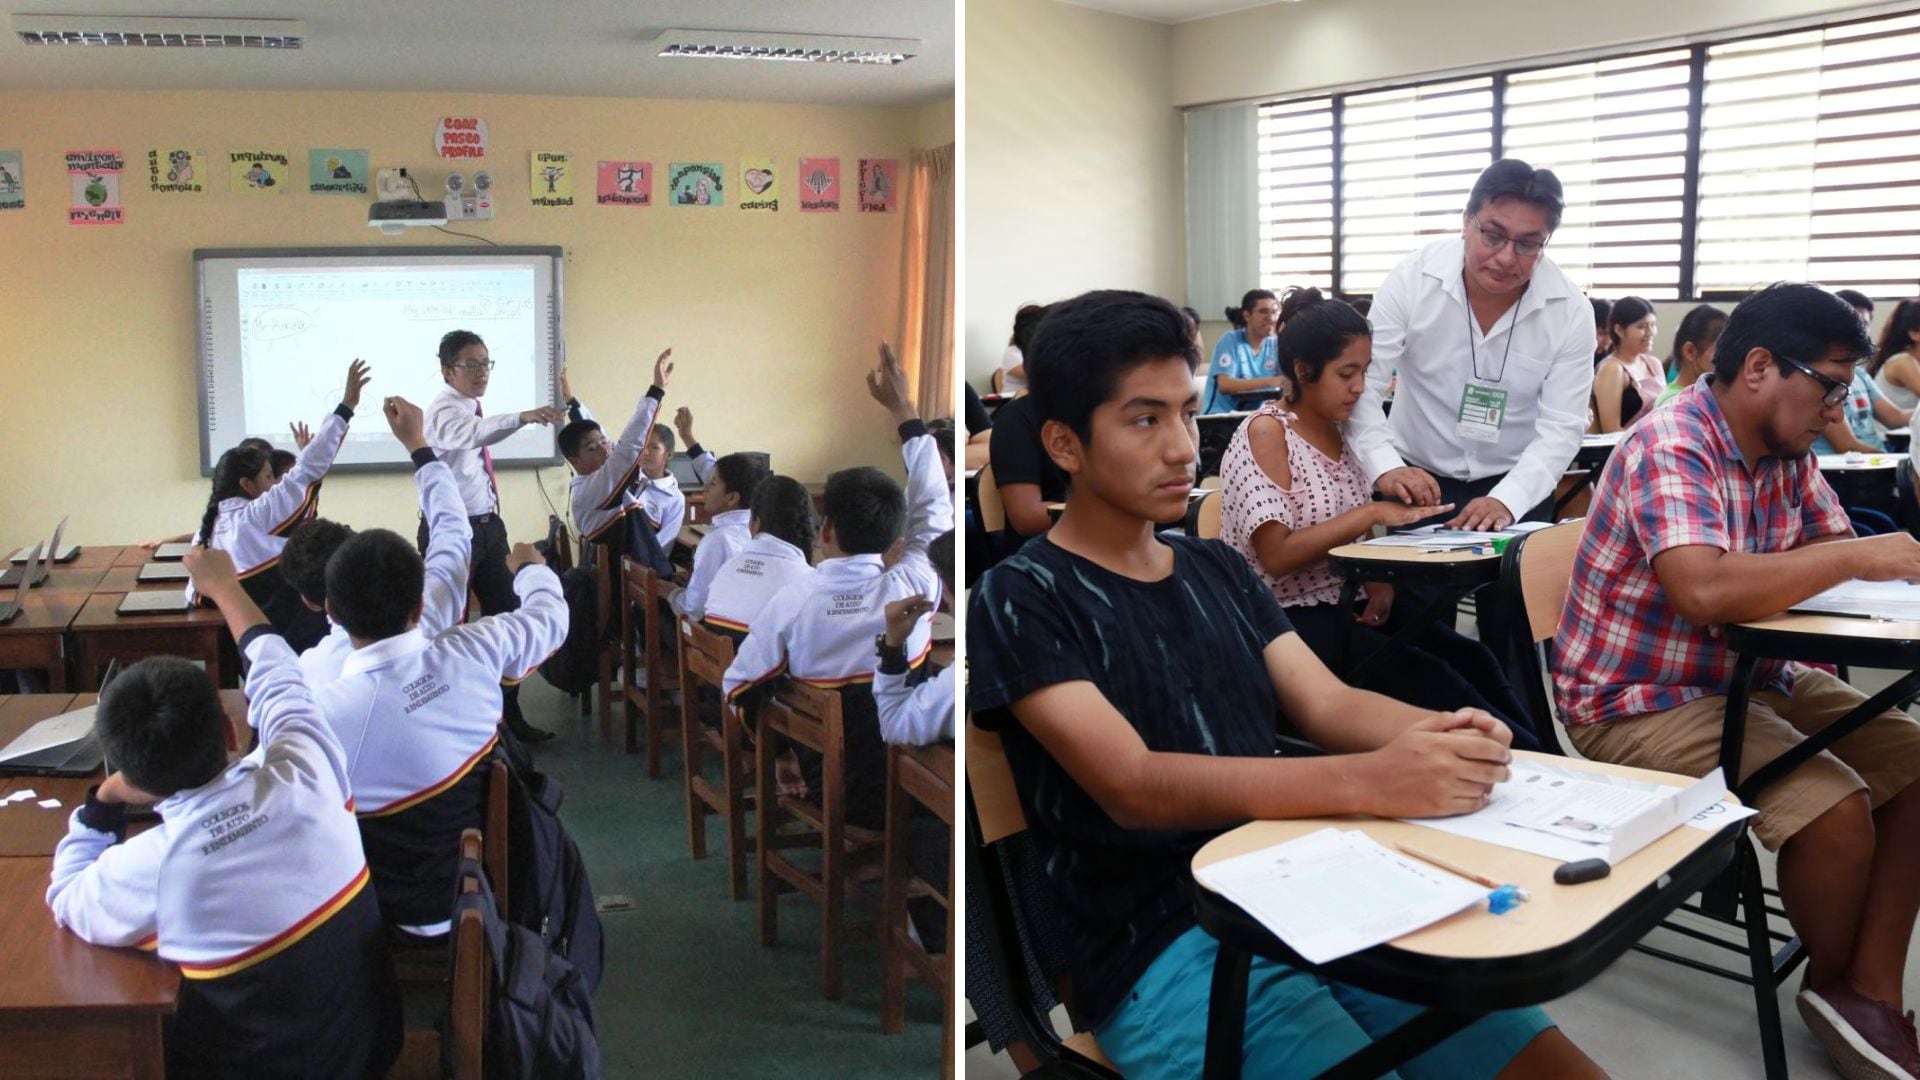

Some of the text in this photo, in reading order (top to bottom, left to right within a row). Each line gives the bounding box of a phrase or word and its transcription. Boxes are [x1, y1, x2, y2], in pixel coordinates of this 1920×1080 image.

[442, 132, 481, 145] PASCO
[440, 145, 485, 158] PROFILE
[402, 673, 434, 694] COLEGIOS
[409, 681, 436, 701] DE ALTO
[201, 802, 250, 829] COLEGIOS
[209, 813, 250, 838] DE ALTO
[202, 814, 269, 856] RENDIMIENTO
